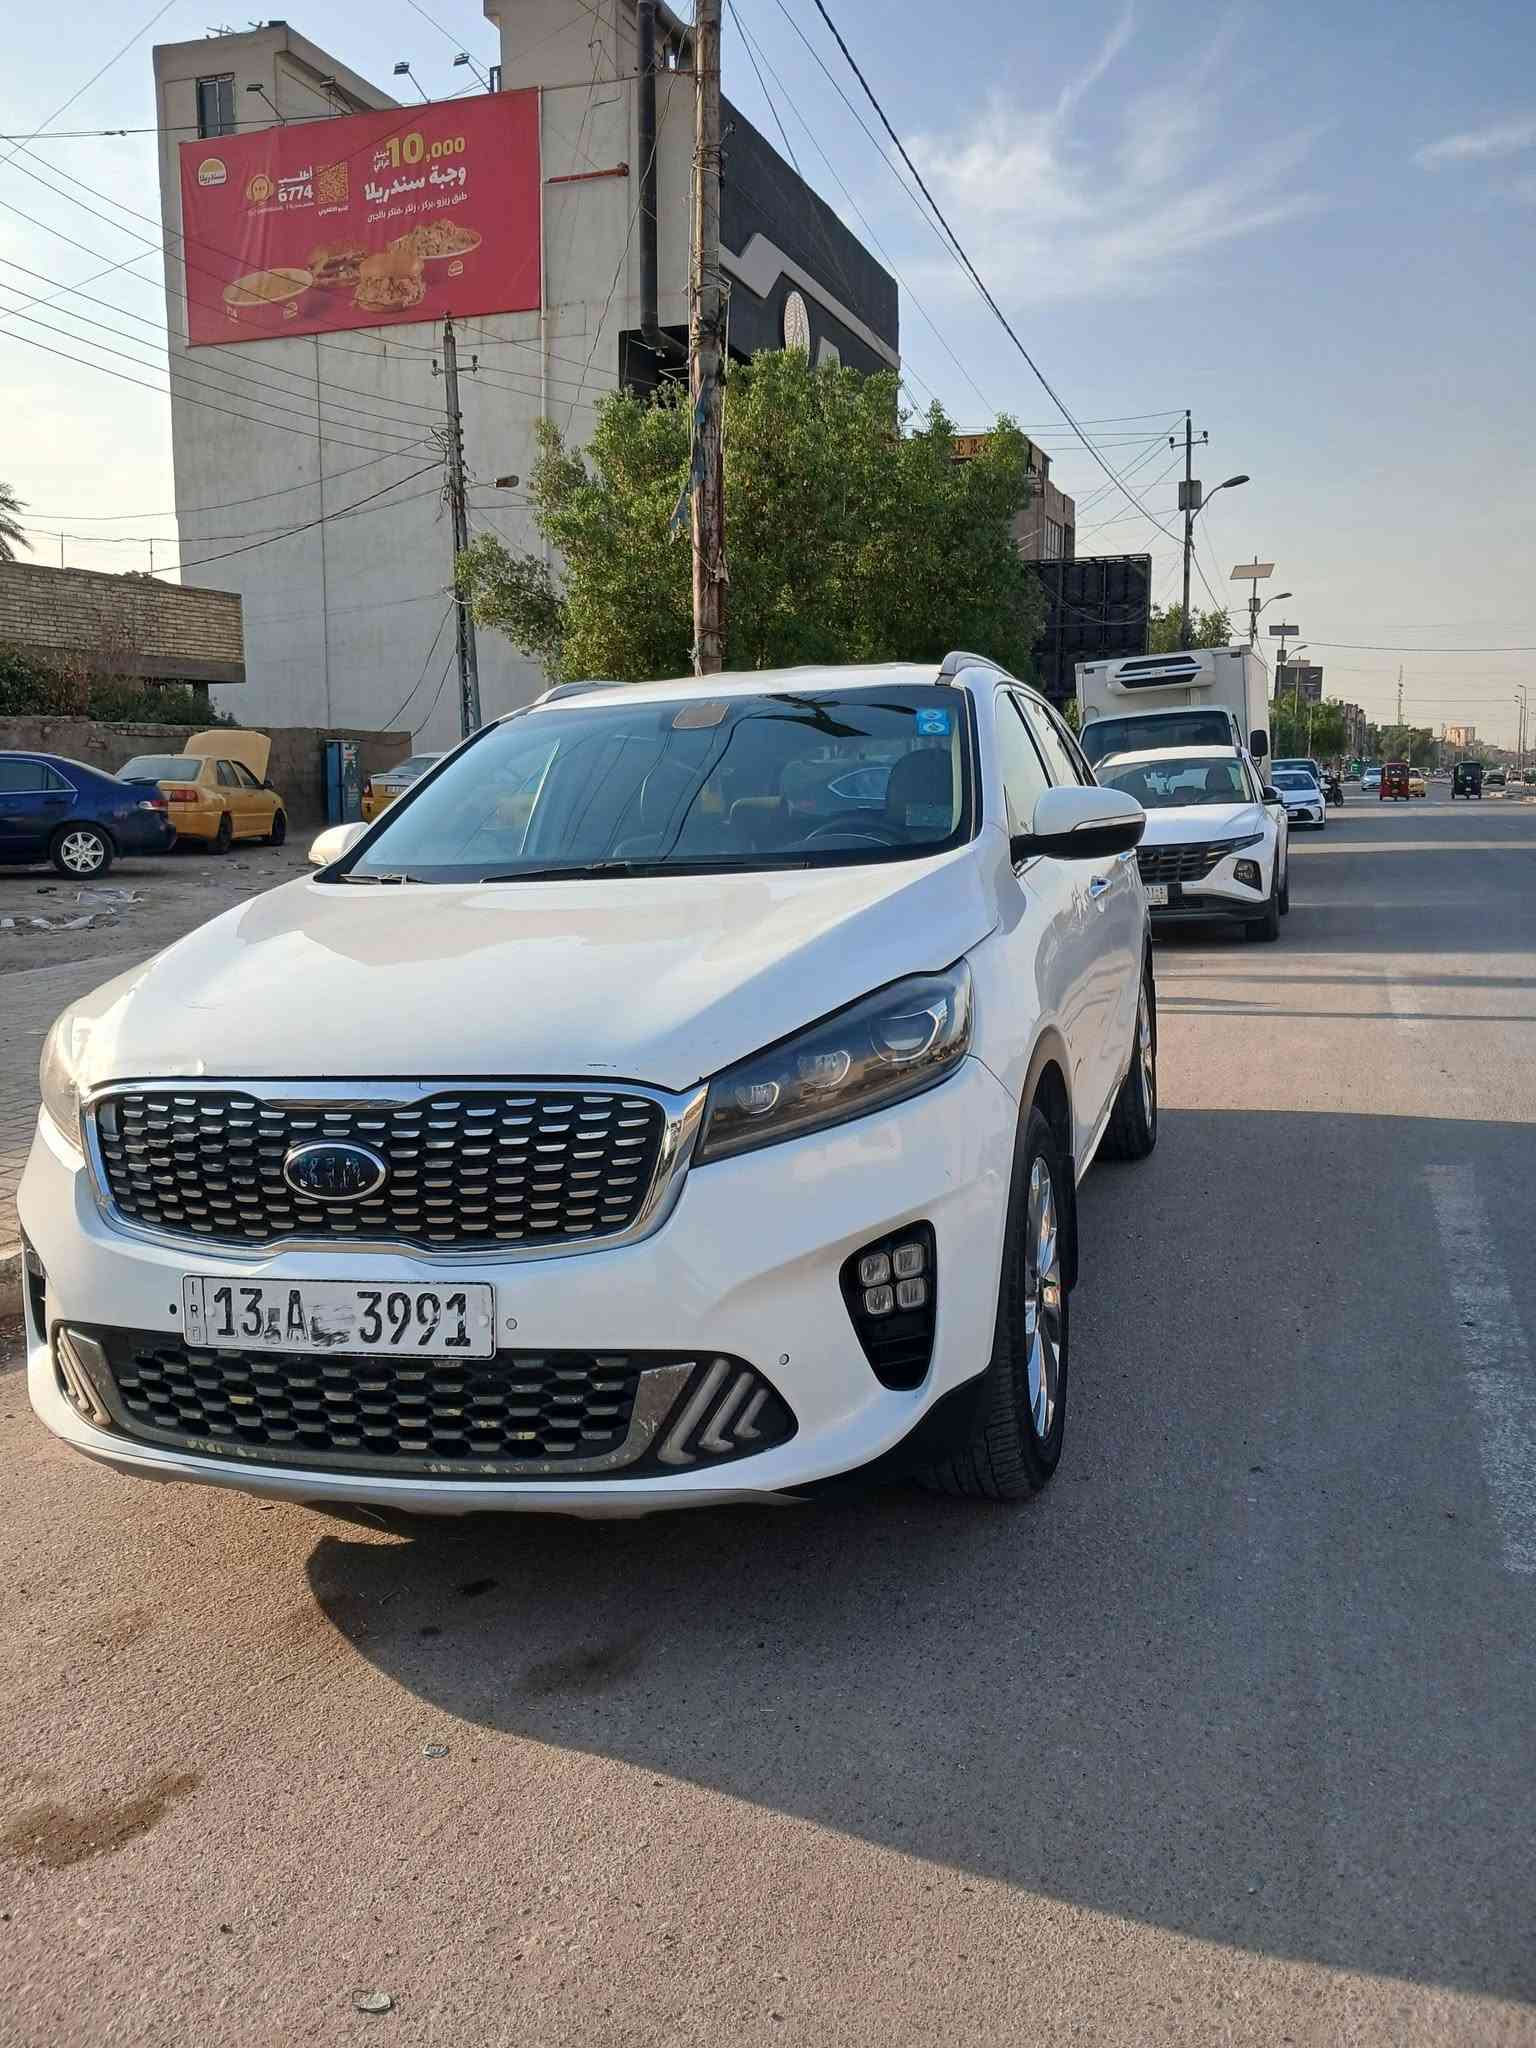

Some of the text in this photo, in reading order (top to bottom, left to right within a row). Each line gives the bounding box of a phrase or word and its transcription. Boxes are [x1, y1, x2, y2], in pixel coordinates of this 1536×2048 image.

[278, 183, 314, 203] 6774
[364, 165, 467, 204] وجبة سندريلا
[213, 1286, 265, 1337] 13
[356, 1291, 471, 1347] 3991
